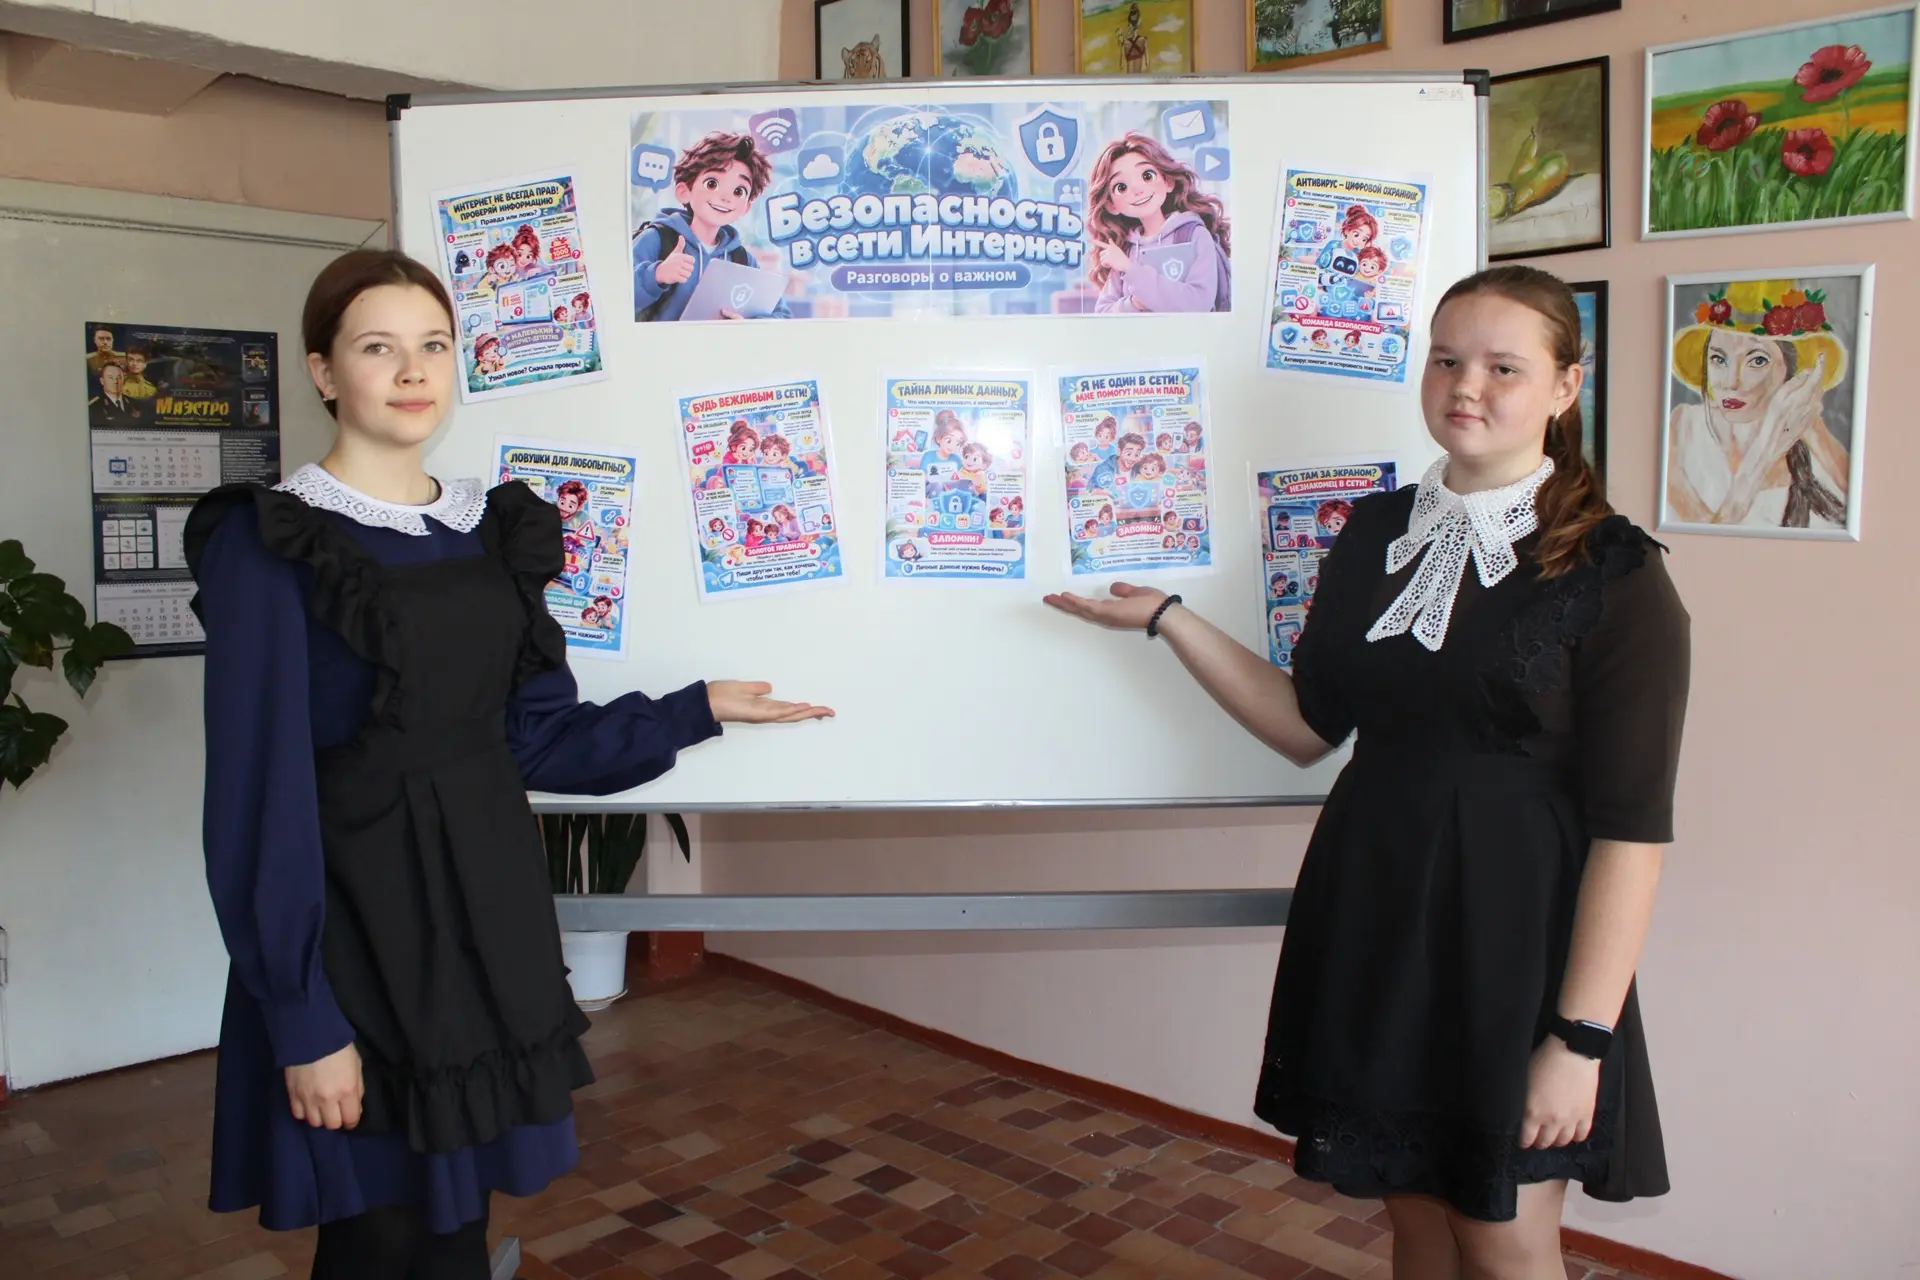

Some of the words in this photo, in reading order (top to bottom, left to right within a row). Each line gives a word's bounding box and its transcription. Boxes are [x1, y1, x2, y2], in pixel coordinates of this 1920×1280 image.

[1296, 177, 1337, 188] АНТИВИРУС
[1345, 181, 1382, 194] ЦИФРОВОЙ
[1383, 187, 1418, 201] ОХРАННИК
[453, 195, 492, 213] ИНТЕРНЕТ
[494, 193, 504, 203] НЕ
[506, 188, 535, 201] ВСЕГДА
[536, 186, 559, 196] ПРАВ!
[460, 205, 498, 221] ПРОВЕРЯЙ
[499, 197, 553, 213] ИНФОРМАЦИЮ
[480, 217, 505, 226] Правда
[519, 210, 537, 218] ложь?
[767, 193, 1084, 241] Безопасность
[790, 239, 813, 265] в
[818, 228, 902, 262] сети
[910, 224, 1082, 265] Интернет
[553, 248, 569, 257] 1000
[847, 271, 933, 286] Разговоры
[939, 273, 949, 283] о
[954, 270, 1017, 283] важном
[511, 325, 553, 339] МАЛЕНЬКИЙ
[1302, 318, 1333, 328] КОМАНДА
[1335, 321, 1380, 333] БЕЗОПАСНОСТИ
[528, 364, 554, 373] Сначала
[897, 383, 931, 397] ТАЙНА
[934, 385, 974, 395] ЛИЧНЫХ
[975, 385, 1018, 398] ДАННЫХ
[1081, 381, 1090, 392] Я
[1092, 380, 1105, 390] НЕ
[1108, 376, 1136, 388] ОДИН
[1139, 375, 1146, 385] В
[1148, 374, 1179, 385] СЕТИ!
[692, 400, 717, 413] БУДЬ
[719, 391, 774, 408] ВЕЖЛИВЫМ
[784, 388, 808, 398] СЕТИ!
[1075, 391, 1095, 402] МНЕ
[1096, 388, 1131, 400] ПОМОГУТ
[1133, 387, 1155, 395] МАМА
[1163, 386, 1185, 395] ПАПА
[510, 453, 551, 464] ЛОВУШКИ
[552, 455, 569, 466] ДЛЯ
[569, 457, 626, 474] ЛЮБОПЫТНЫХ
[1279, 474, 1299, 486] КТО
[1300, 471, 1318, 481] ТАМ
[1321, 470, 1331, 478] ЗА
[1333, 468, 1377, 477] ЭКРАНОМ?
[1289, 481, 1338, 493] НЕЗНАКОМЕЦ
[1346, 479, 1368, 487] СЕТИ!
[1117, 523, 1161, 535] ЗАПОМНИ!
[931, 534, 980, 544] ЗАПОМНИ!
[748, 545, 775, 555] ЗОЛОТОЕ
[776, 542, 806, 551] ПРАВИЛО
[753, 568, 772, 576] другим
[981, 564, 1004, 572] беречь!
[764, 572, 785, 580] писали
